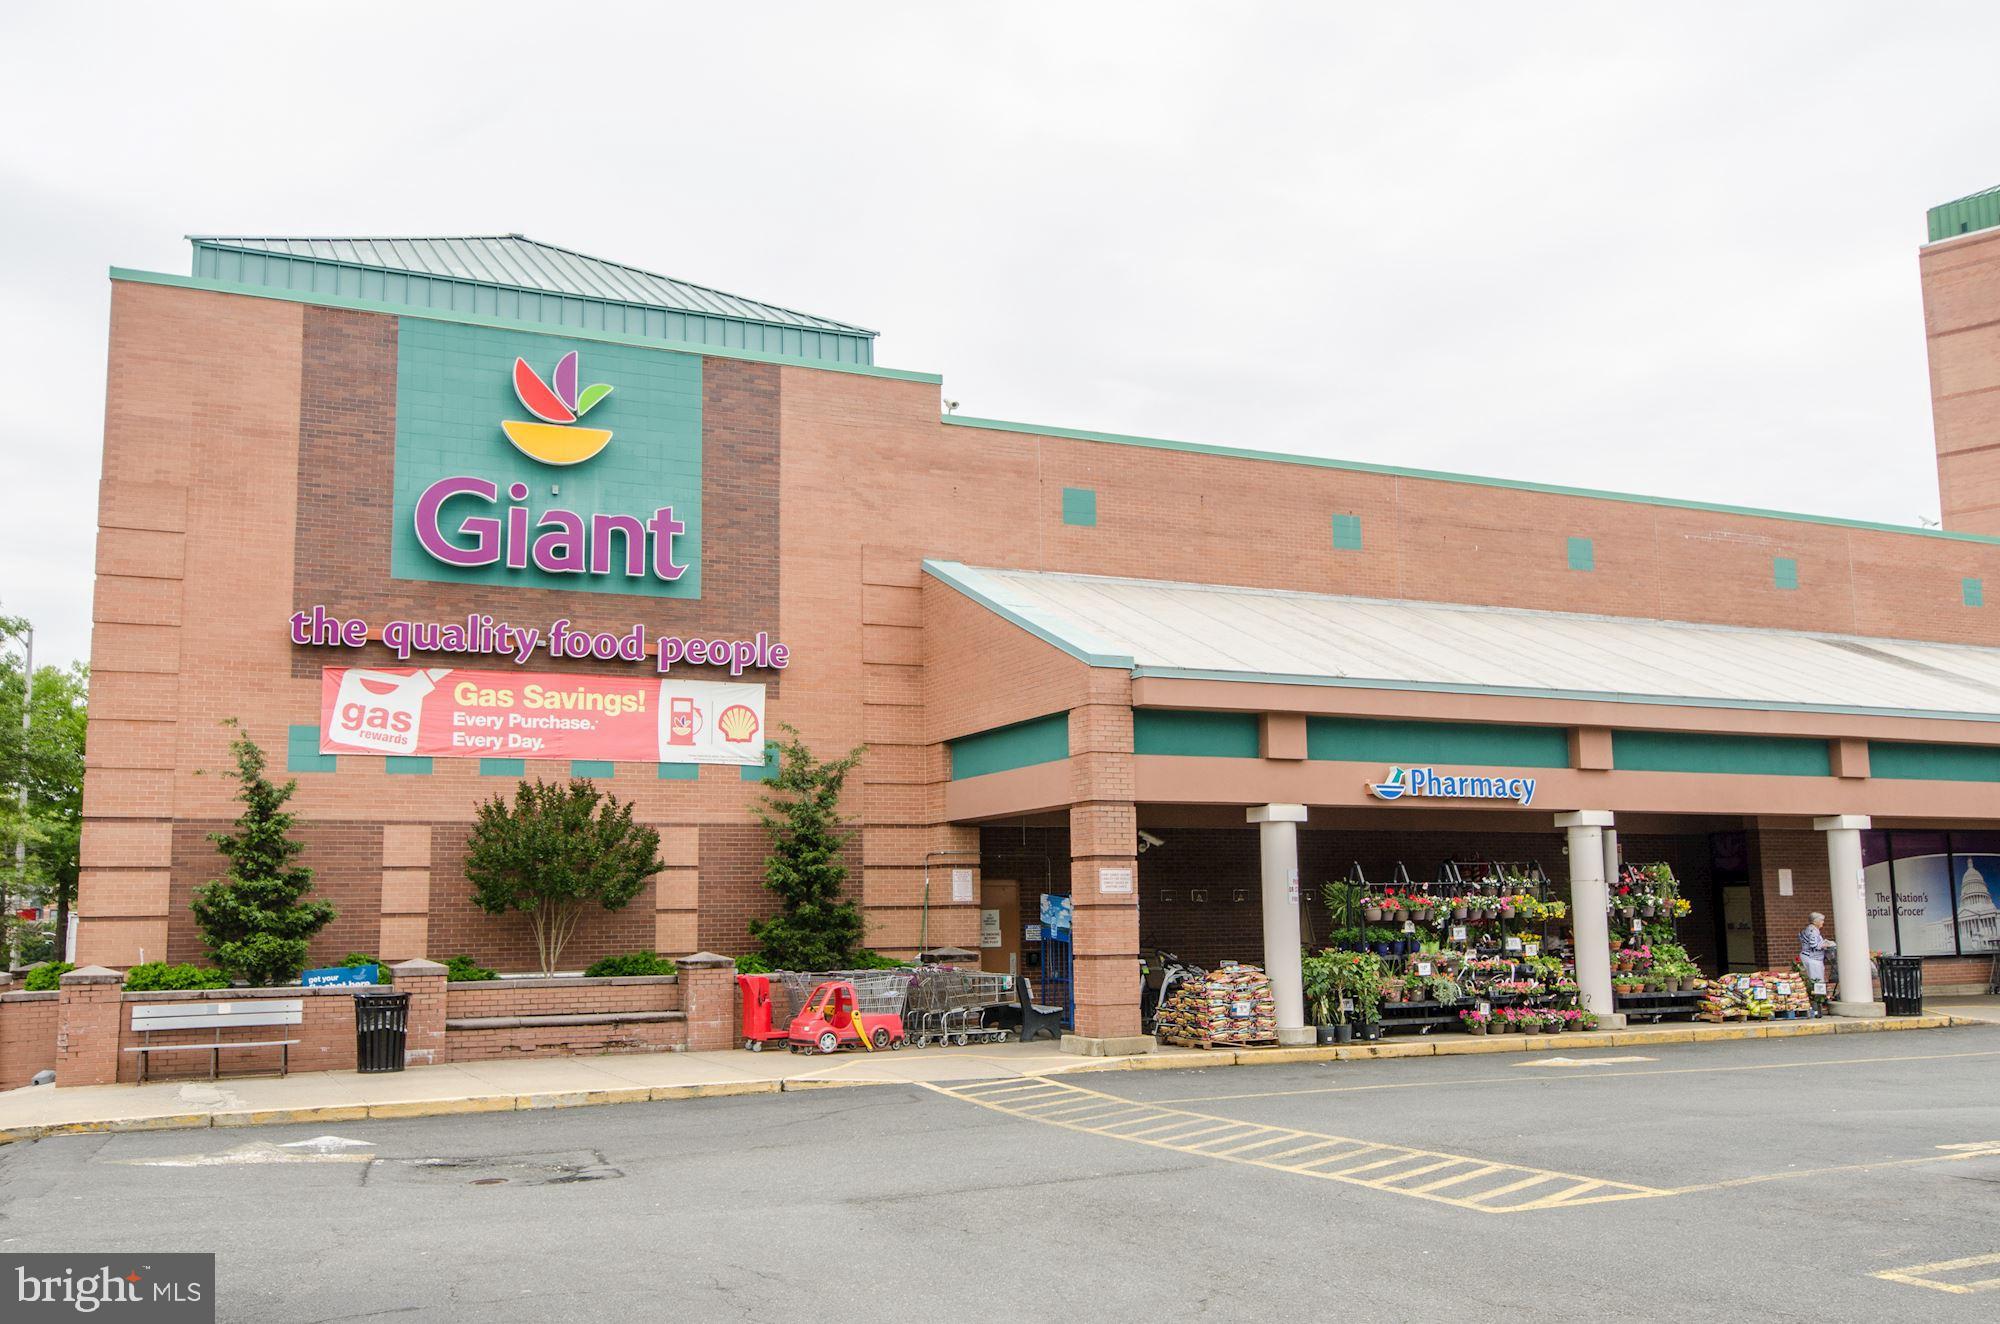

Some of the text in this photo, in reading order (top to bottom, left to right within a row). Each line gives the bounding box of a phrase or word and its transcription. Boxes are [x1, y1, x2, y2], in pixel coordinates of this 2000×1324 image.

[413, 475, 690, 581] Giant
[289, 605, 791, 676] the quality food people
[453, 682, 646, 716] Gas Savings!
[341, 702, 412, 733] gas
[453, 713, 503, 732] Every
[359, 730, 408, 746] rewards
[453, 731, 545, 750] Every Day.
[1410, 767, 1536, 806] Pharmacy
[1875, 892, 1929, 903] The Nation's
[1866, 906, 1891, 918] apital
[322, 975, 339, 983] your
